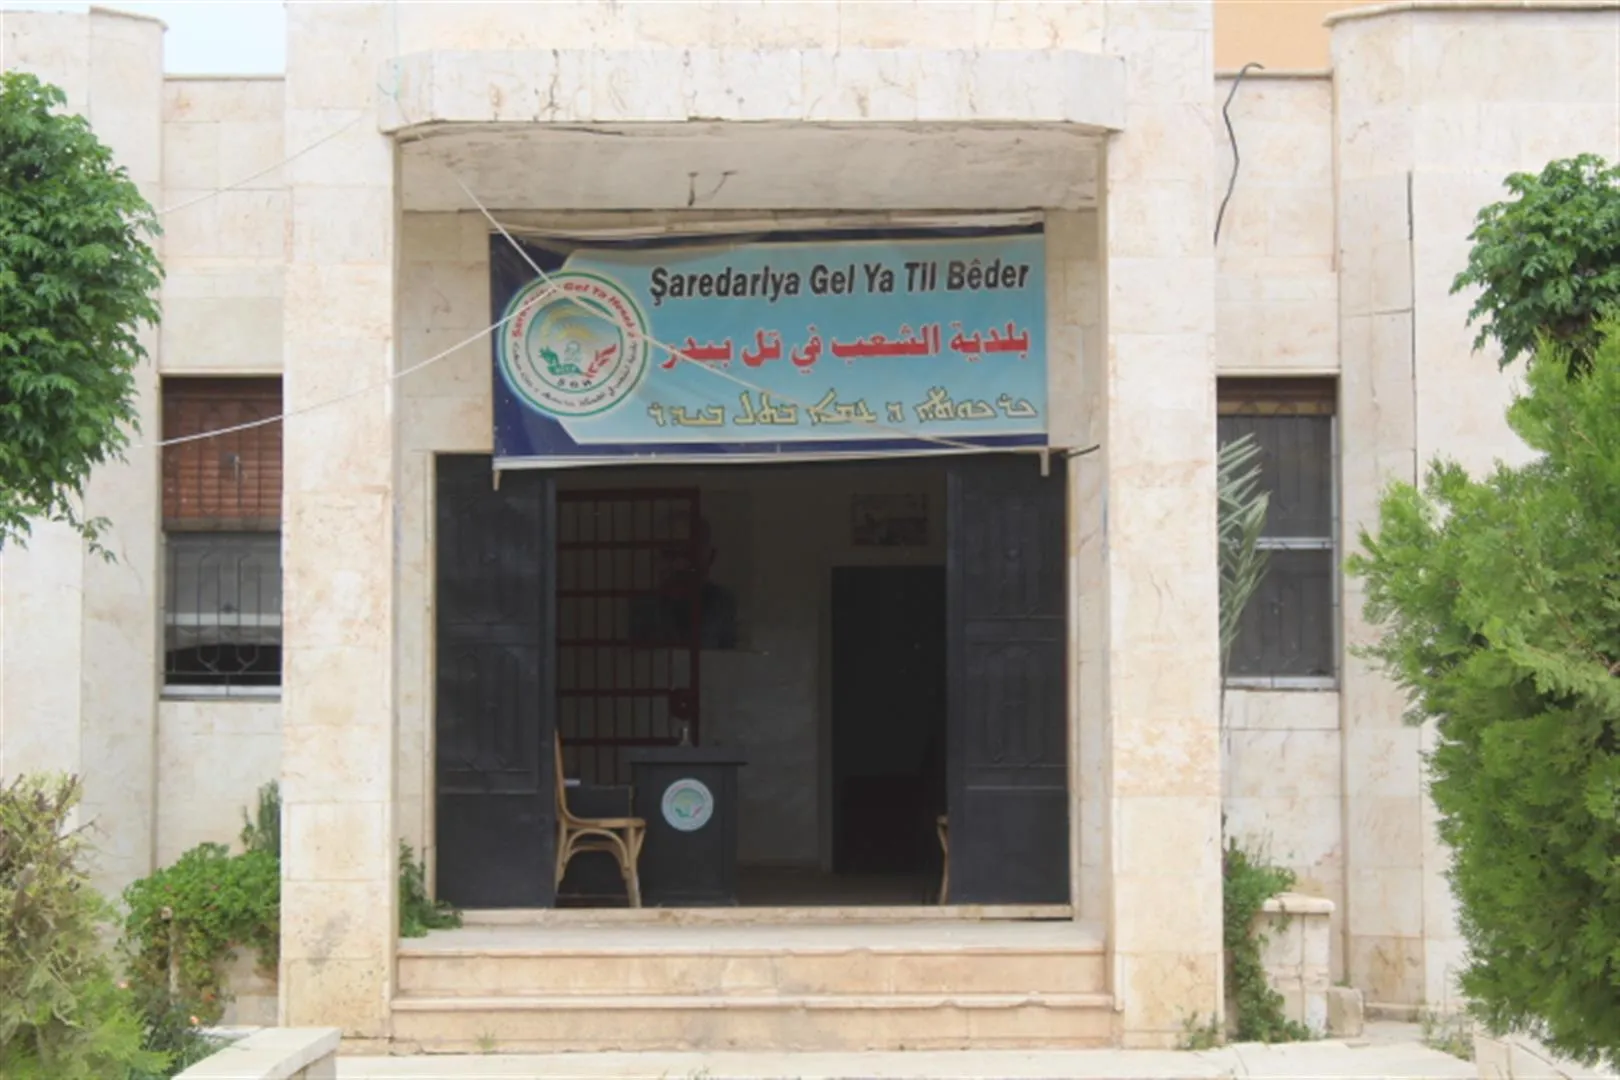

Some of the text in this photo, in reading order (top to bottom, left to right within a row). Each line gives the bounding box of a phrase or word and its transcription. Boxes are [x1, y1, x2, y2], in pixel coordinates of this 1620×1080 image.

[809, 263, 856, 295] Gel
[863, 262, 895, 293] Ya
[946, 257, 1030, 291] Bêder
[660, 321, 1029, 374] بلدية الشعب في تل بيدر
